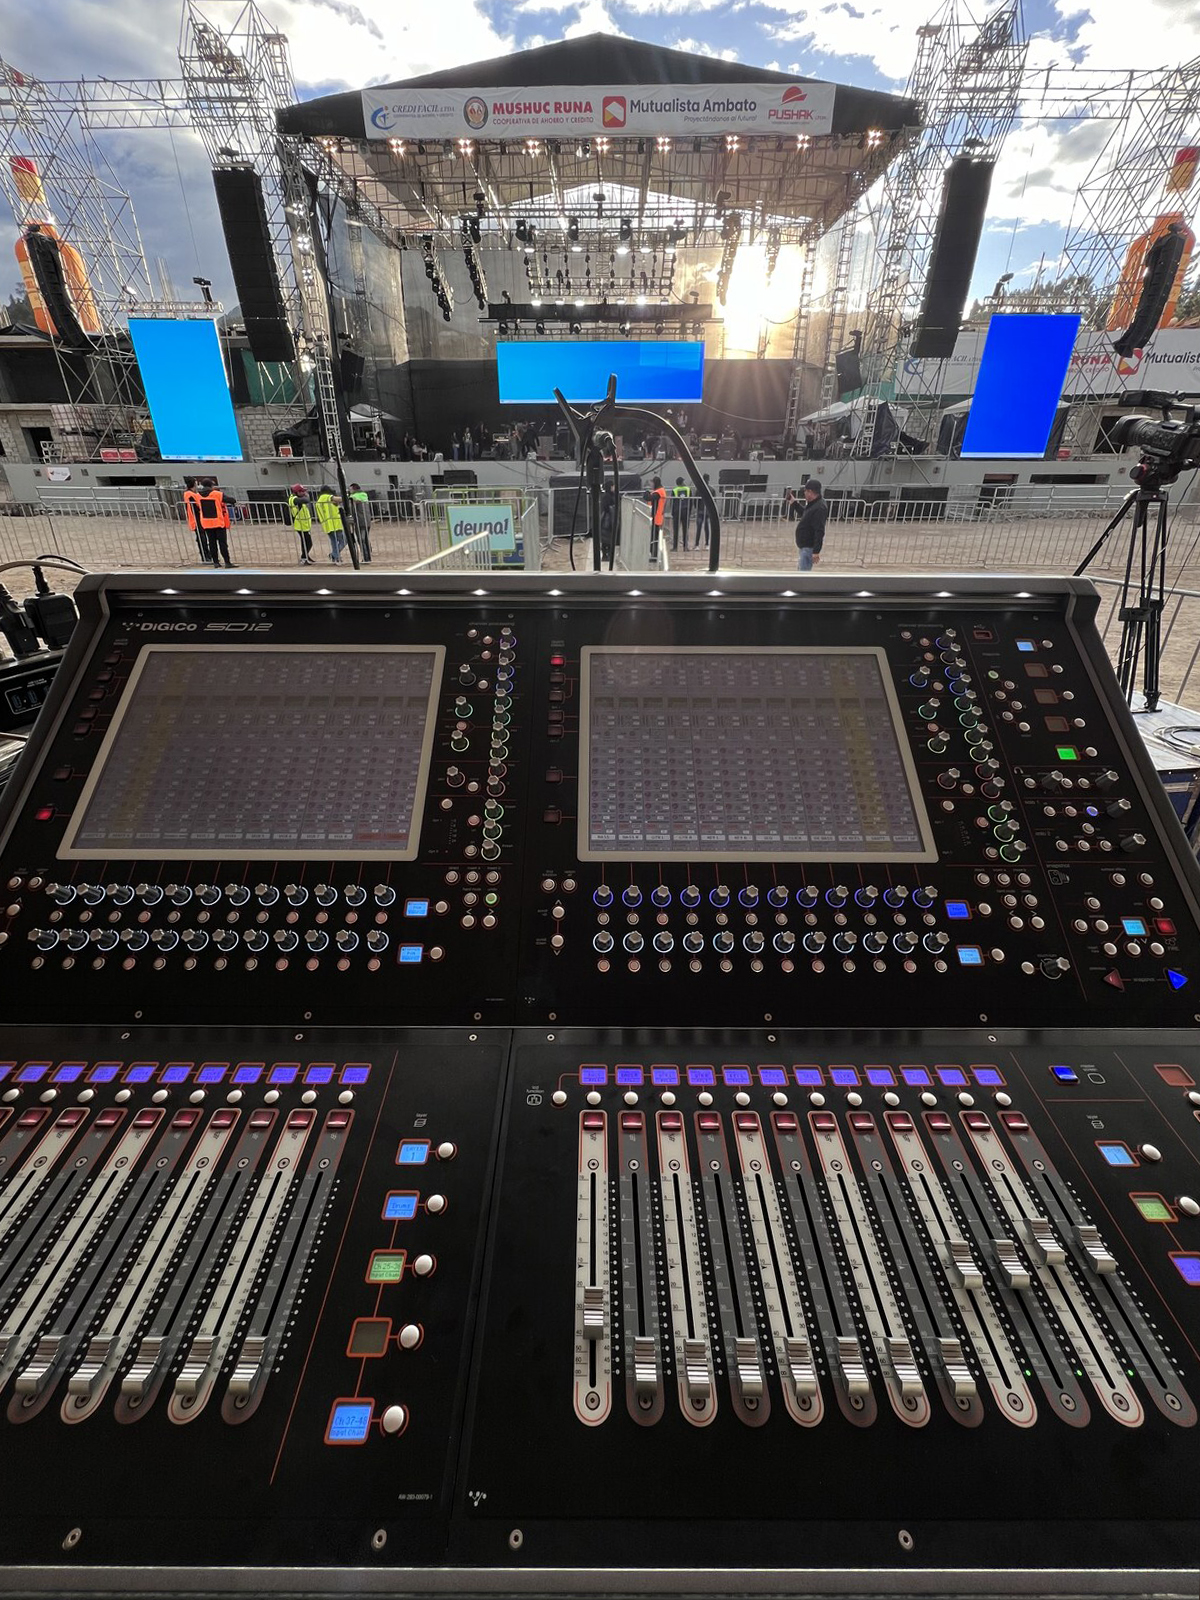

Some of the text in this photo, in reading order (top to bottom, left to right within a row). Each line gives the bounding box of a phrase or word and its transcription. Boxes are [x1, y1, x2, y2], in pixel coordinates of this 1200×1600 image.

[492, 101, 593, 114] MUSHUC RUNA
[630, 98, 757, 113] Mutualista Ambato
[454, 518, 509, 536] deuna!
[140, 623, 273, 632] DiGiCo SD12
